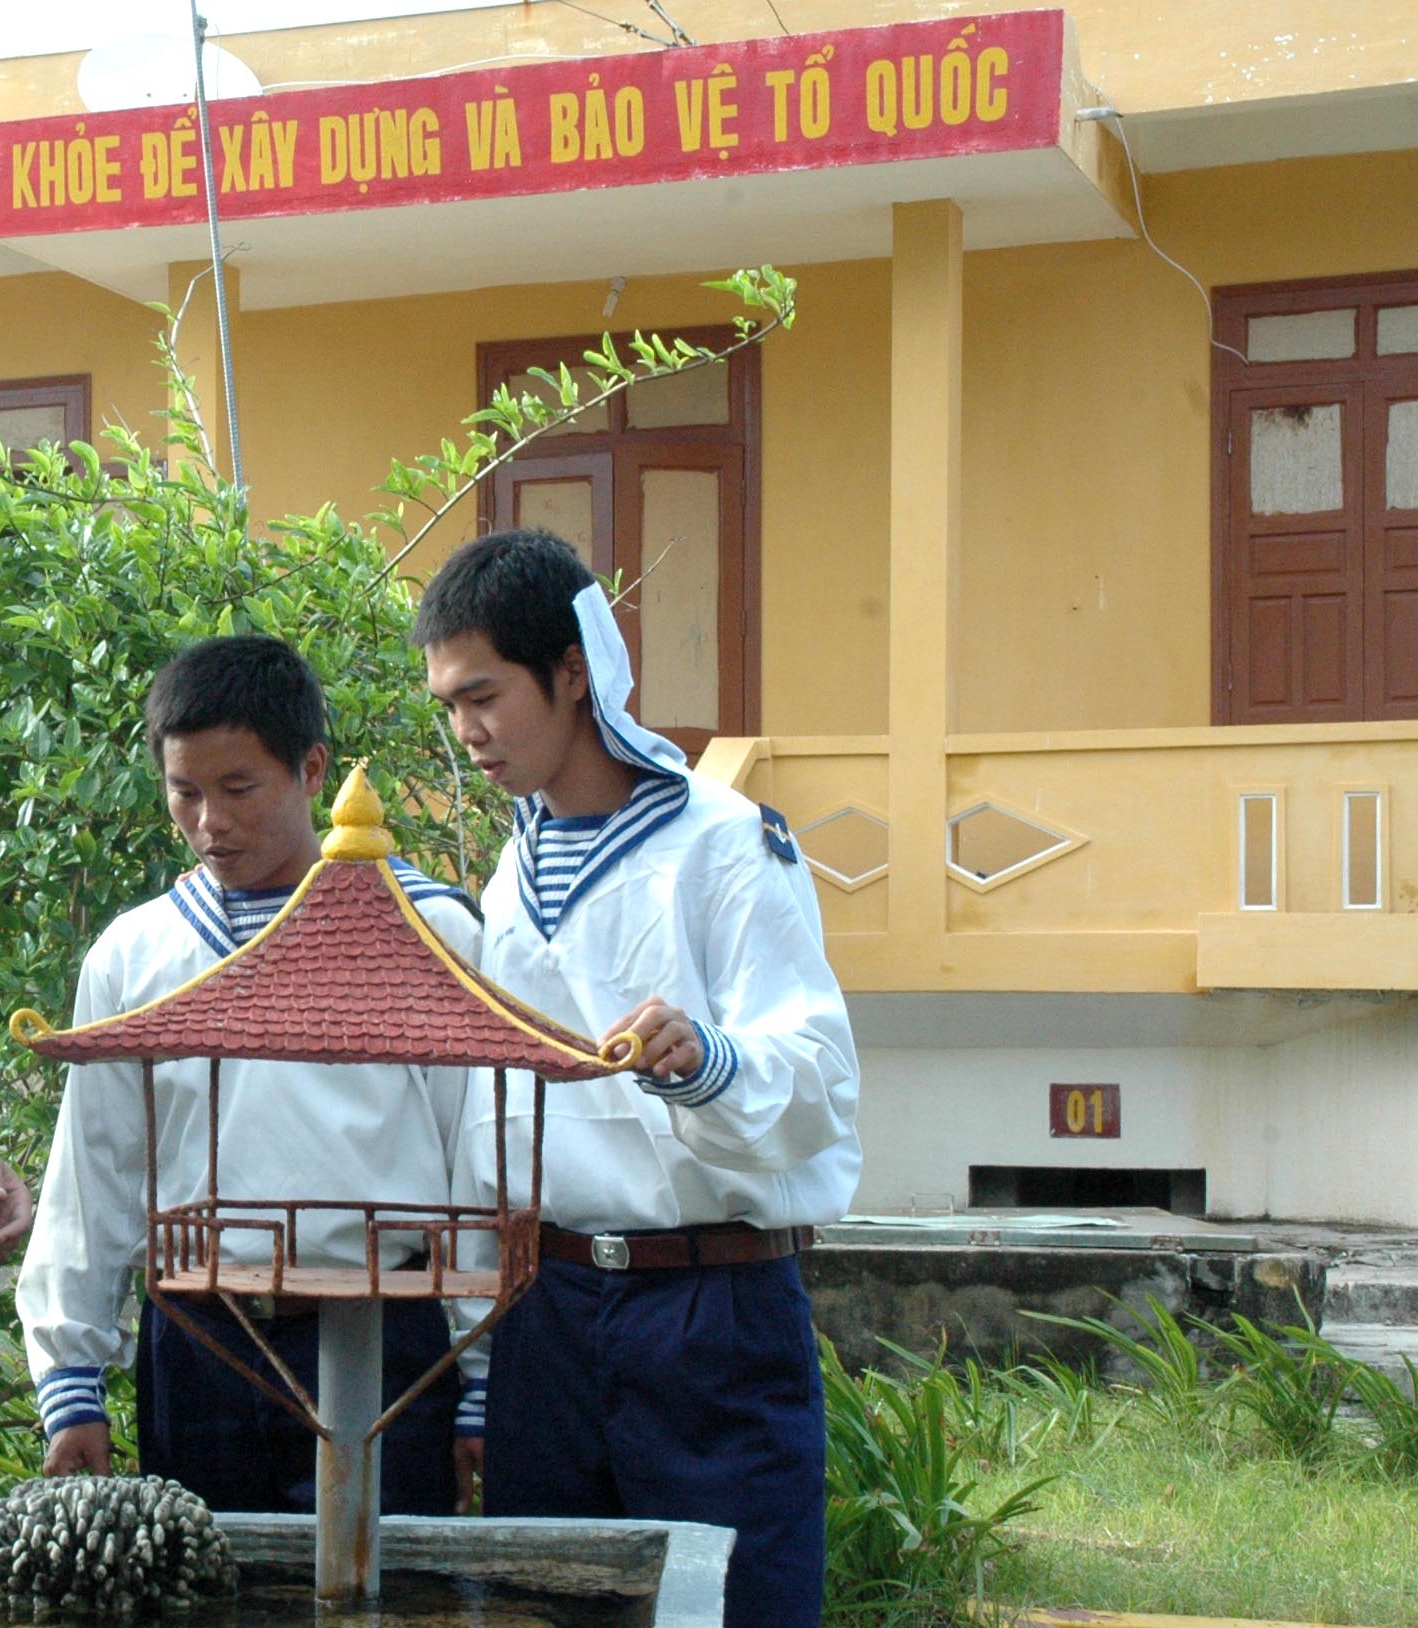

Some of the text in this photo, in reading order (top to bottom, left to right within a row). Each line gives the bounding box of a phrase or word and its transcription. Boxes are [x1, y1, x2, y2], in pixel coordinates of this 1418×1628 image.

[12, 24, 1009, 210] KHỎE ĐỂ XÂY DỰNG VÀ BẢO VỆ TỔ QUỐC
[1067, 1090, 1102, 1133] 01
